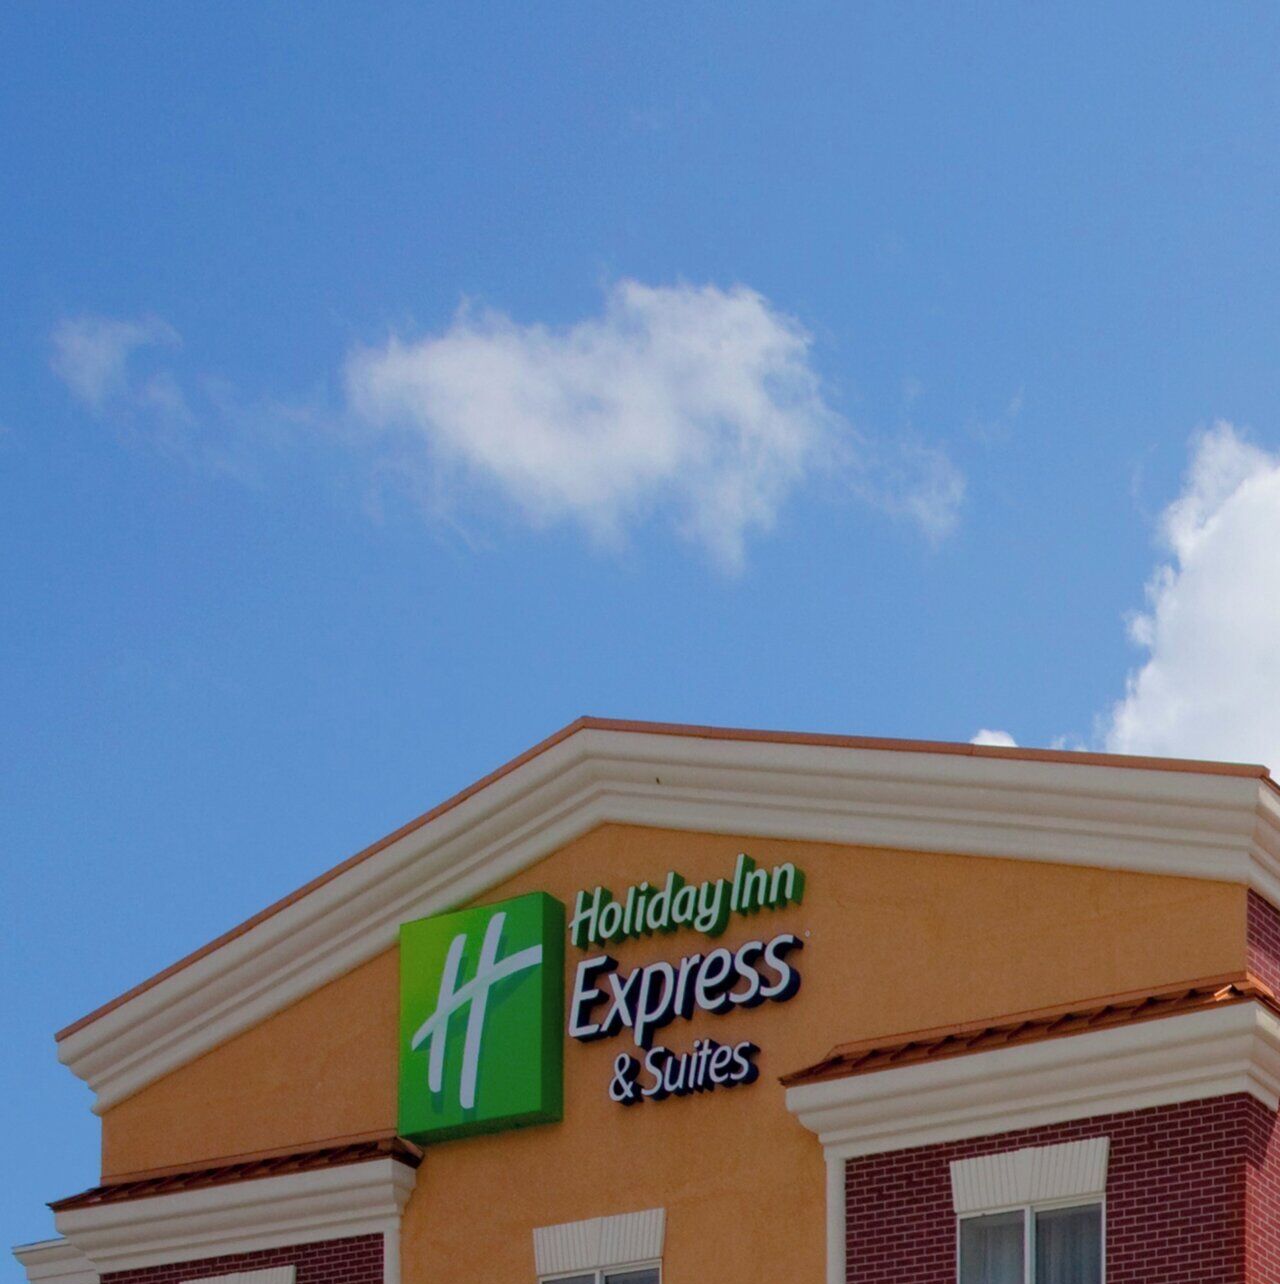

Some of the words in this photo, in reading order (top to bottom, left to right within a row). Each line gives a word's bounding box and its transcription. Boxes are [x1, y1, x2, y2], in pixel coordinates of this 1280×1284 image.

[568, 870, 729, 948] Holiday
[729, 852, 805, 916] Inn
[567, 933, 804, 1047] Express
[608, 1051, 640, 1104] &
[639, 1038, 760, 1100] Suites
